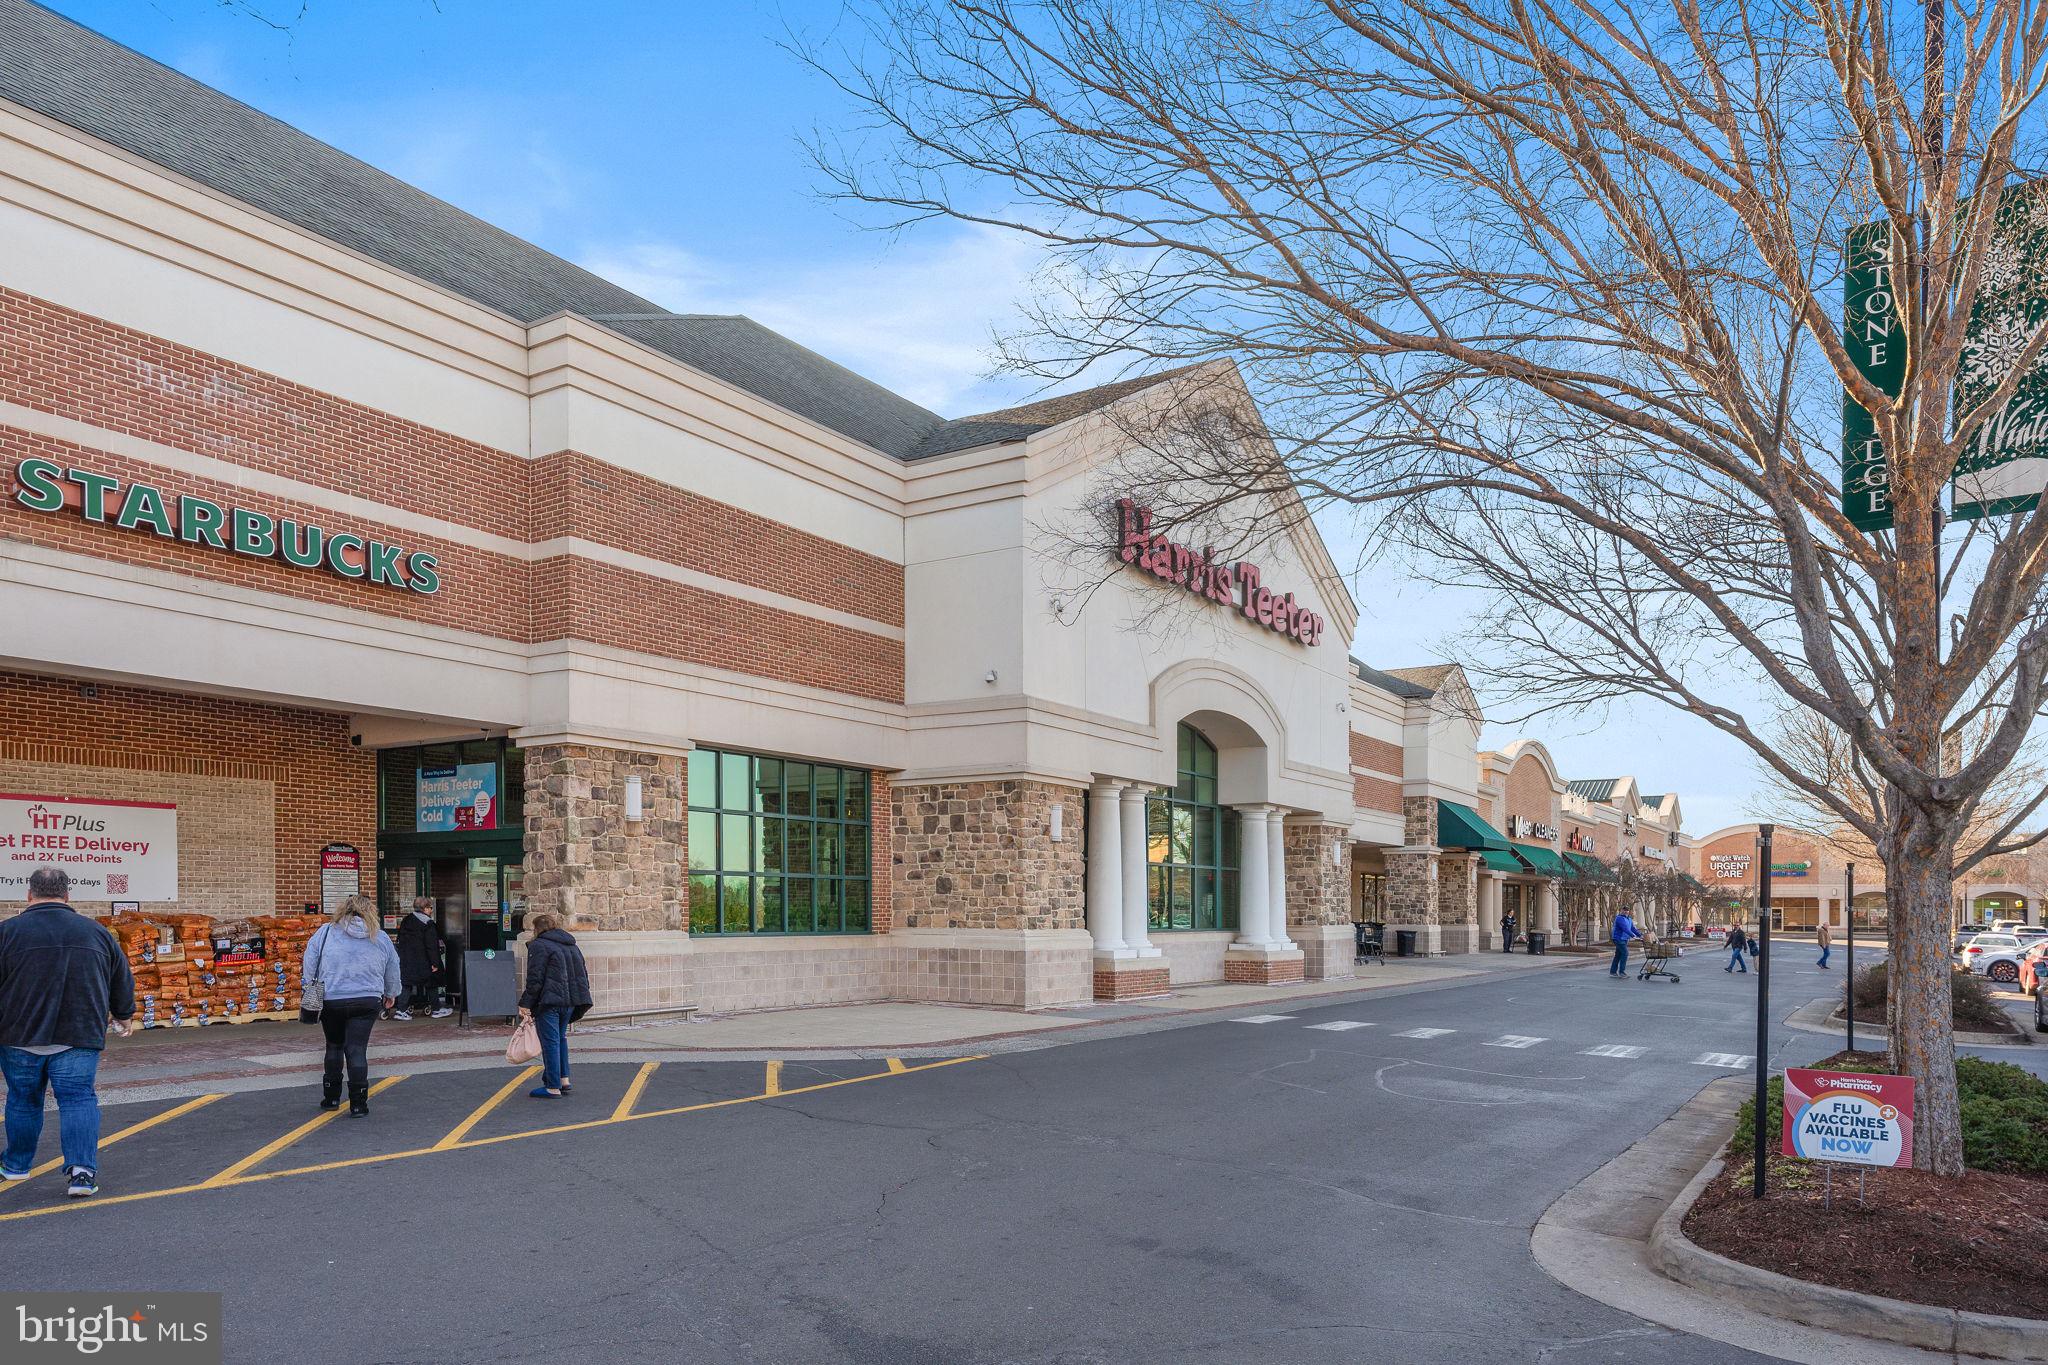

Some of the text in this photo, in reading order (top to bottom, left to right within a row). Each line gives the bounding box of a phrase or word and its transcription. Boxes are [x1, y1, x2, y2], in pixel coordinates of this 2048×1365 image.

[1864, 238, 1892, 367] STONE
[14, 458, 440, 594] STARBUCKS
[1116, 498, 1324, 646] Harris Teeter
[421, 777, 483, 793] Harris Teeter
[421, 795, 461, 807] Delivers
[33, 814, 105, 832] HT Plus
[421, 810, 443, 822] Cold
[21, 834, 70, 850] FREE
[75, 836, 150, 856] Delivery
[11, 852, 122, 863] and 2X Fuel Points
[325, 853, 356, 864] Welcome
[1710, 862, 1750, 871] URGENT
[0, 877, 15, 886] Try
[16, 876, 23, 884] it
[1716, 870, 1743, 878] CARE
[80, 878, 101, 887] days
[1830, 1079, 1883, 1093] Pharmacy
[1833, 1103, 1862, 1115] FLU
[1809, 1112, 1886, 1129] VACCINES
[1805, 1124, 1889, 1141] AVAILABLE
[1821, 1137, 1874, 1154] NOW
